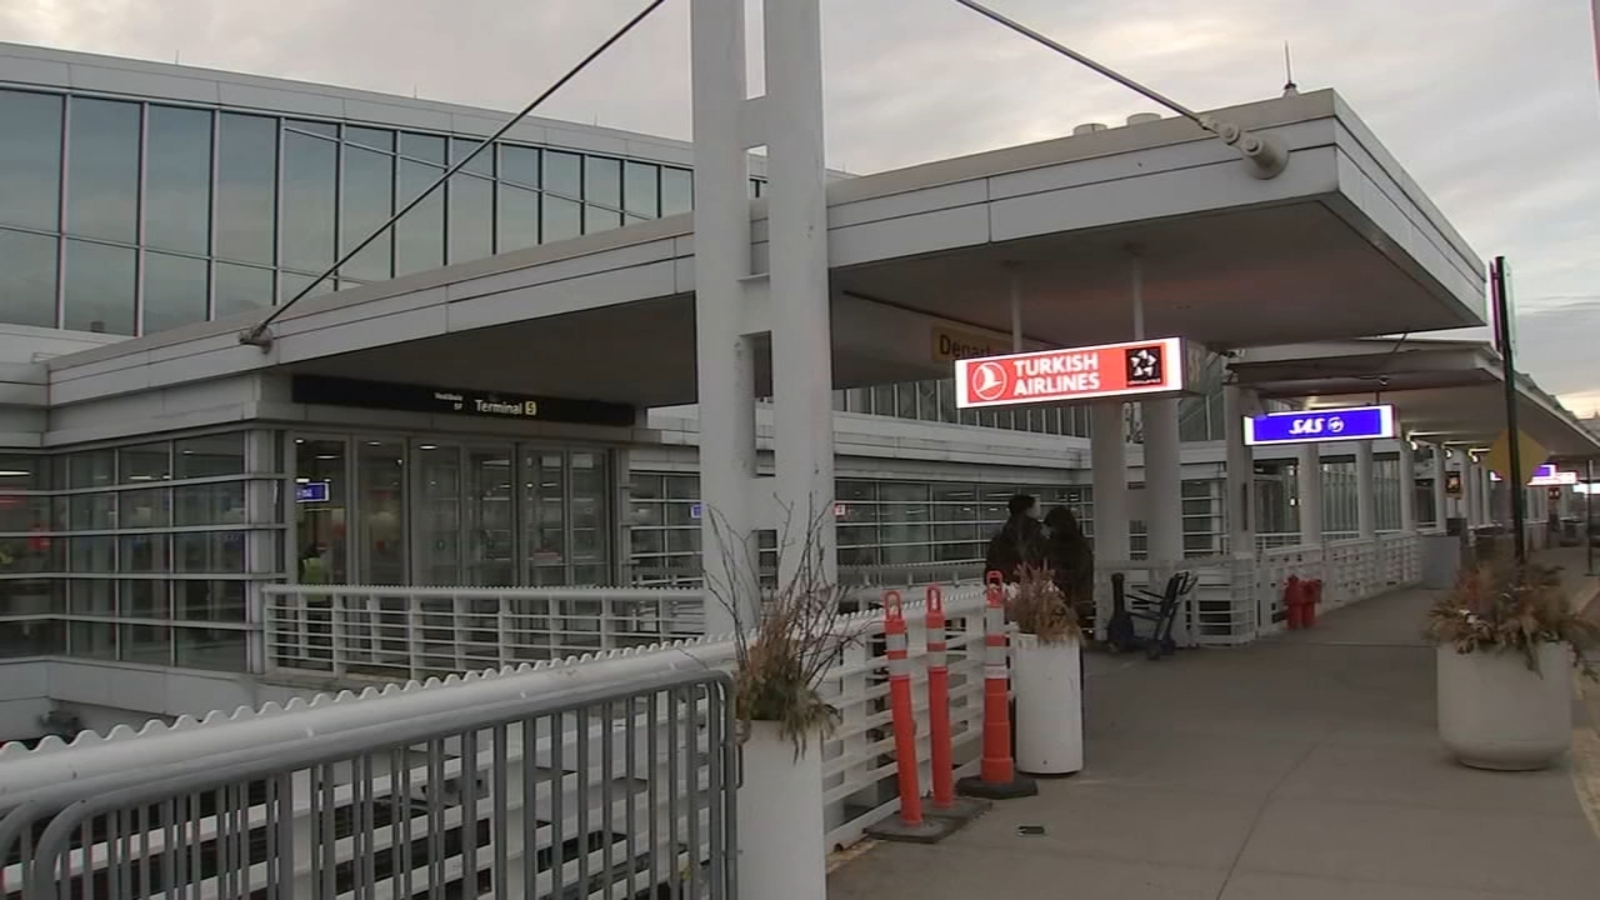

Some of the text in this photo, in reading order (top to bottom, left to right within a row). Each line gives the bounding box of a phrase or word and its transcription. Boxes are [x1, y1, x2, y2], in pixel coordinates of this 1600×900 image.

[1013, 353, 1099, 376] TURKISH
[1013, 372, 1101, 396] AIRLINES
[474, 399, 535, 415] Terminal 5
[1289, 418, 1325, 434] SAS
